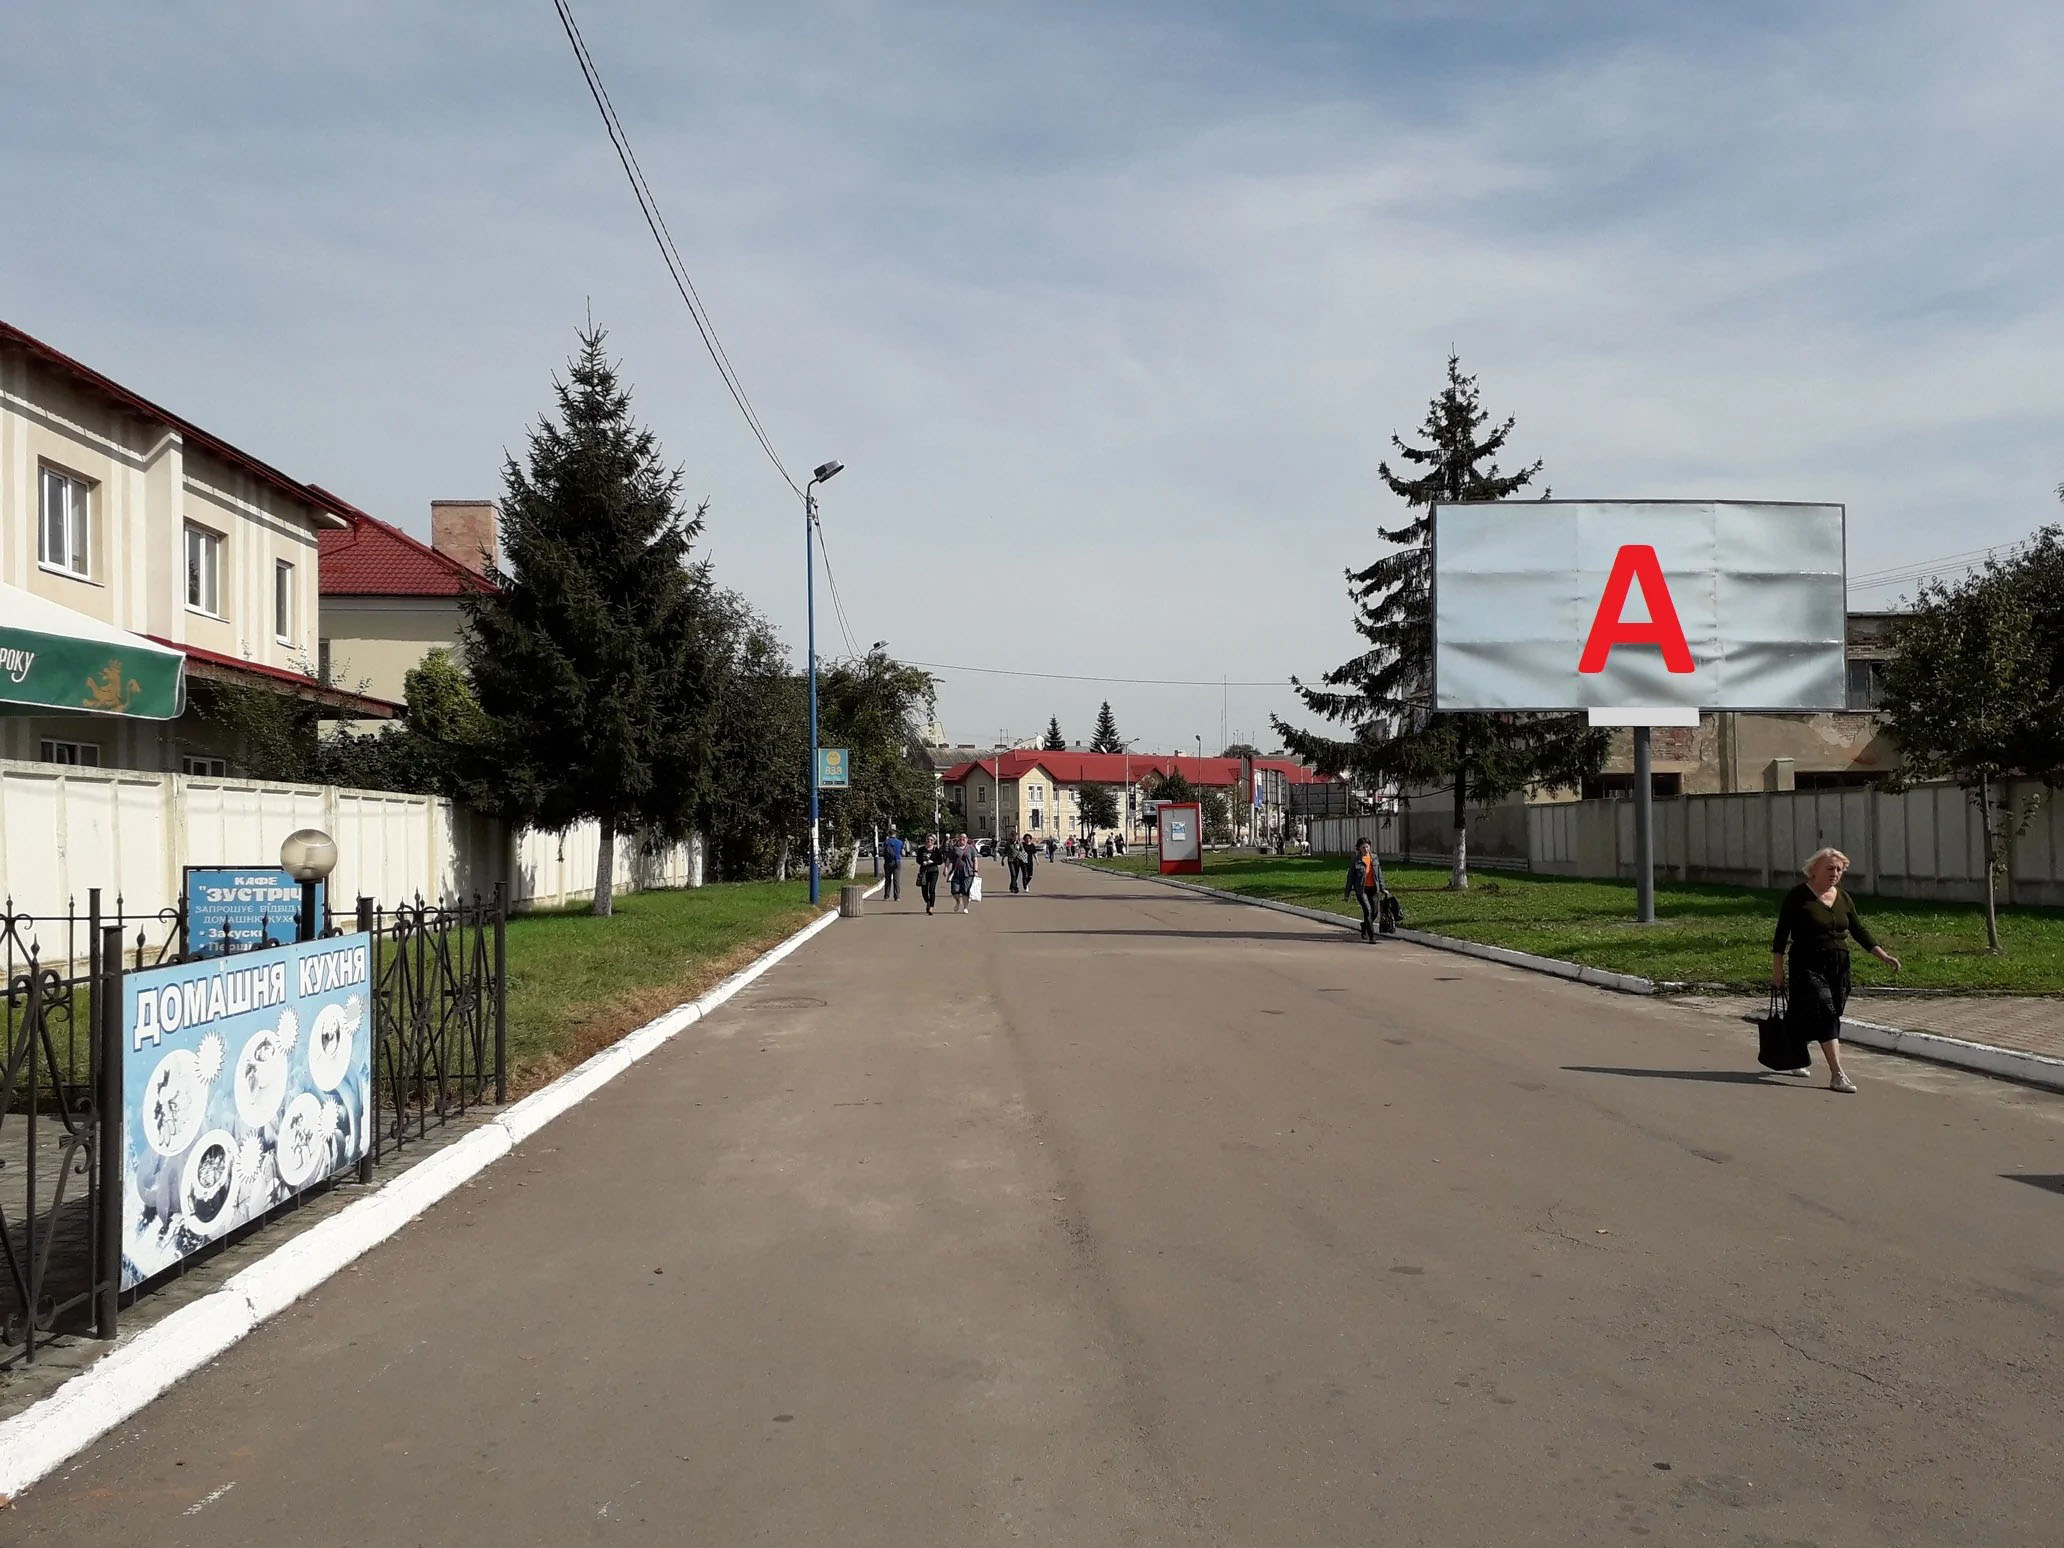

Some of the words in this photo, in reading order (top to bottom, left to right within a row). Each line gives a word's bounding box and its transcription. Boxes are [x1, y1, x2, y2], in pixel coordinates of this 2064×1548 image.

[234, 876, 279, 886] КАФЕ
[195, 904, 254, 913] ЗАПРОШУЄ
[134, 961, 286, 1052] ДОМАШНЯ
[299, 946, 366, 998] КУХНЯ
